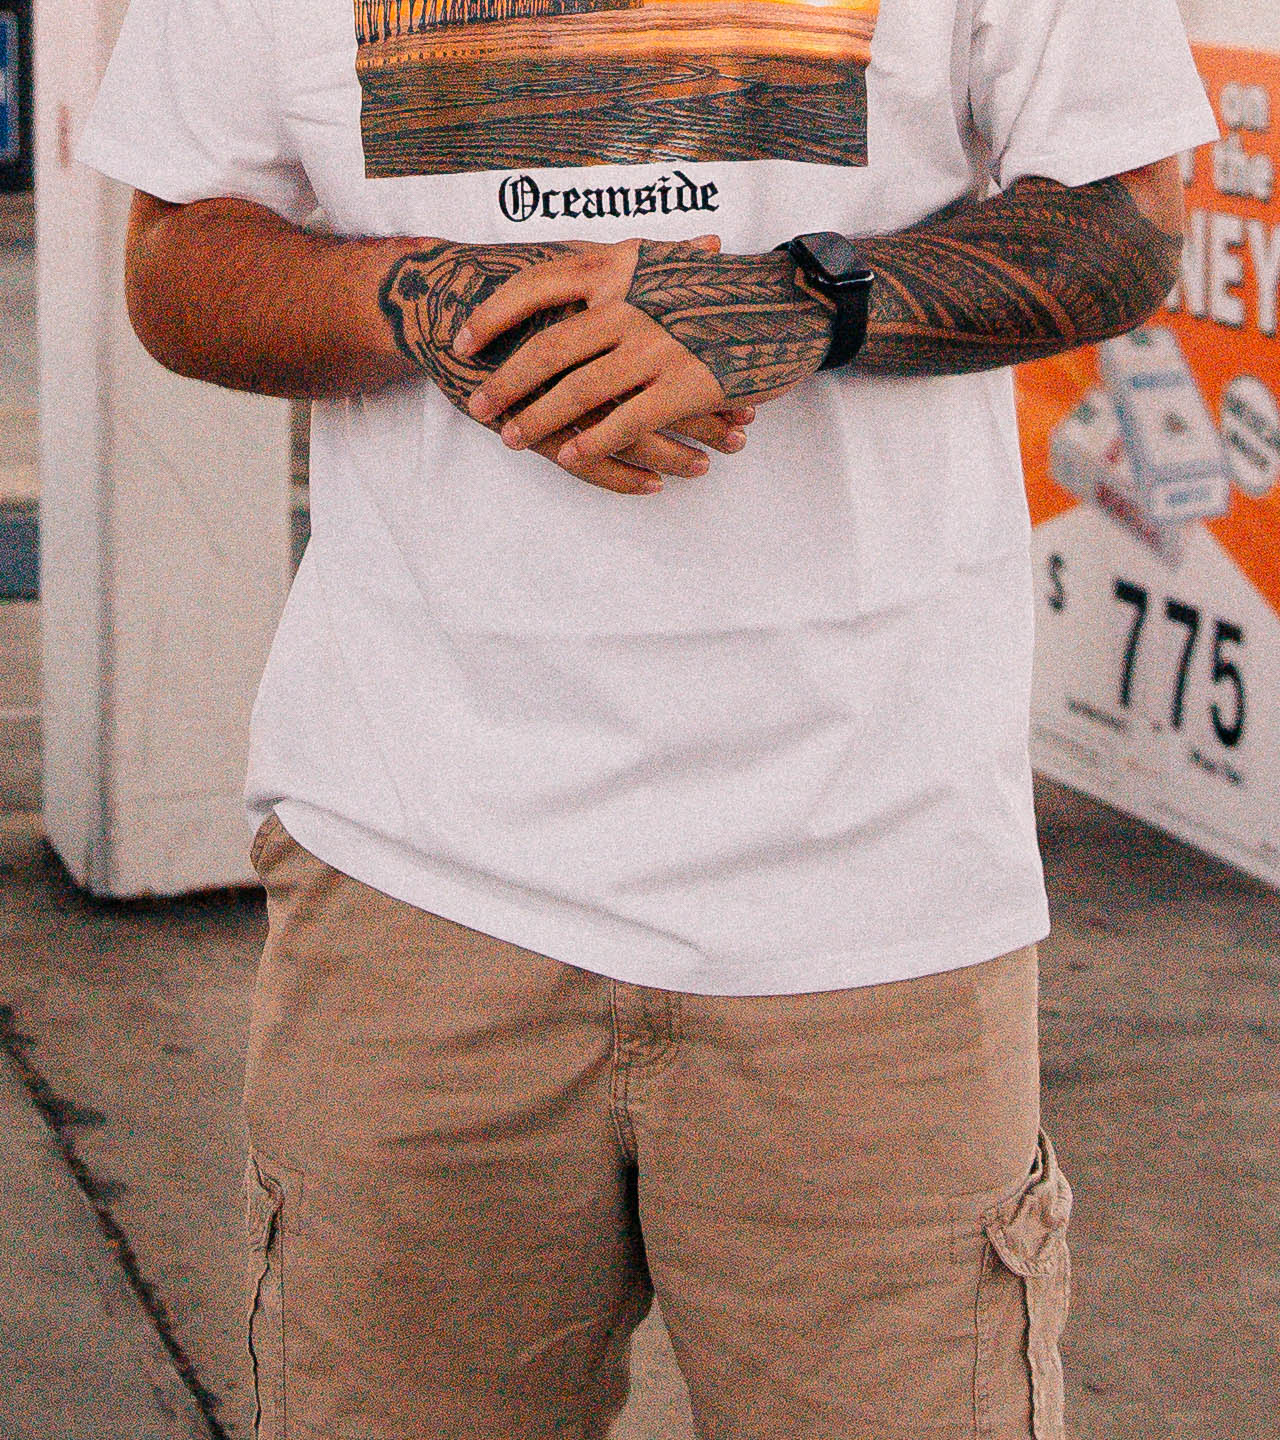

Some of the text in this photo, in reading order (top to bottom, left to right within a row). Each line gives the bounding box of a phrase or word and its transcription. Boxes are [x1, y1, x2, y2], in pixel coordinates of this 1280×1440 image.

[1220, 80, 1270, 133] on
[497, 170, 721, 223] Oceanside
[1212, 132, 1275, 204] the
[1115, 577, 1249, 753] 775
